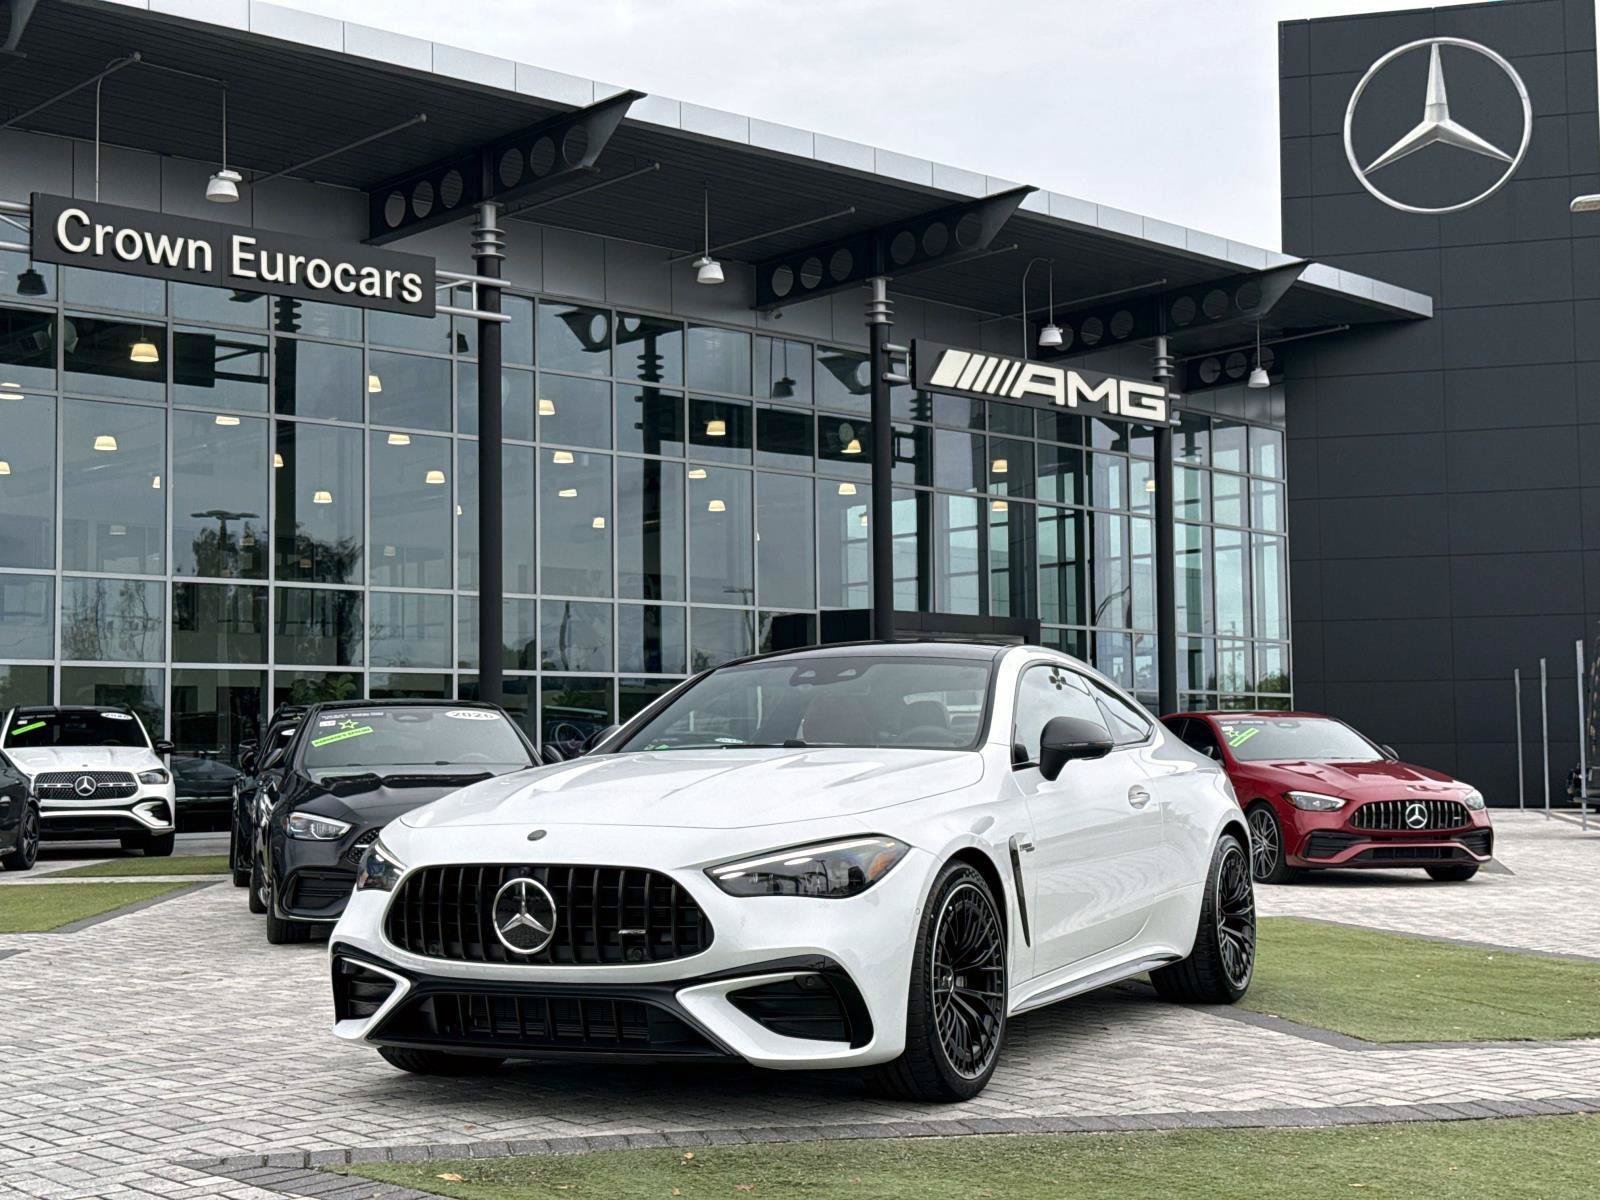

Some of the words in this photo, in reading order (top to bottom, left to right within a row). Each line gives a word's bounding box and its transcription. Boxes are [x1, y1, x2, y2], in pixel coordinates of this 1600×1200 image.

[57, 208, 213, 272] Crown
[232, 234, 423, 303] Eurocars
[1010, 363, 1166, 422] AMG
[452, 711, 494, 719] 2026
